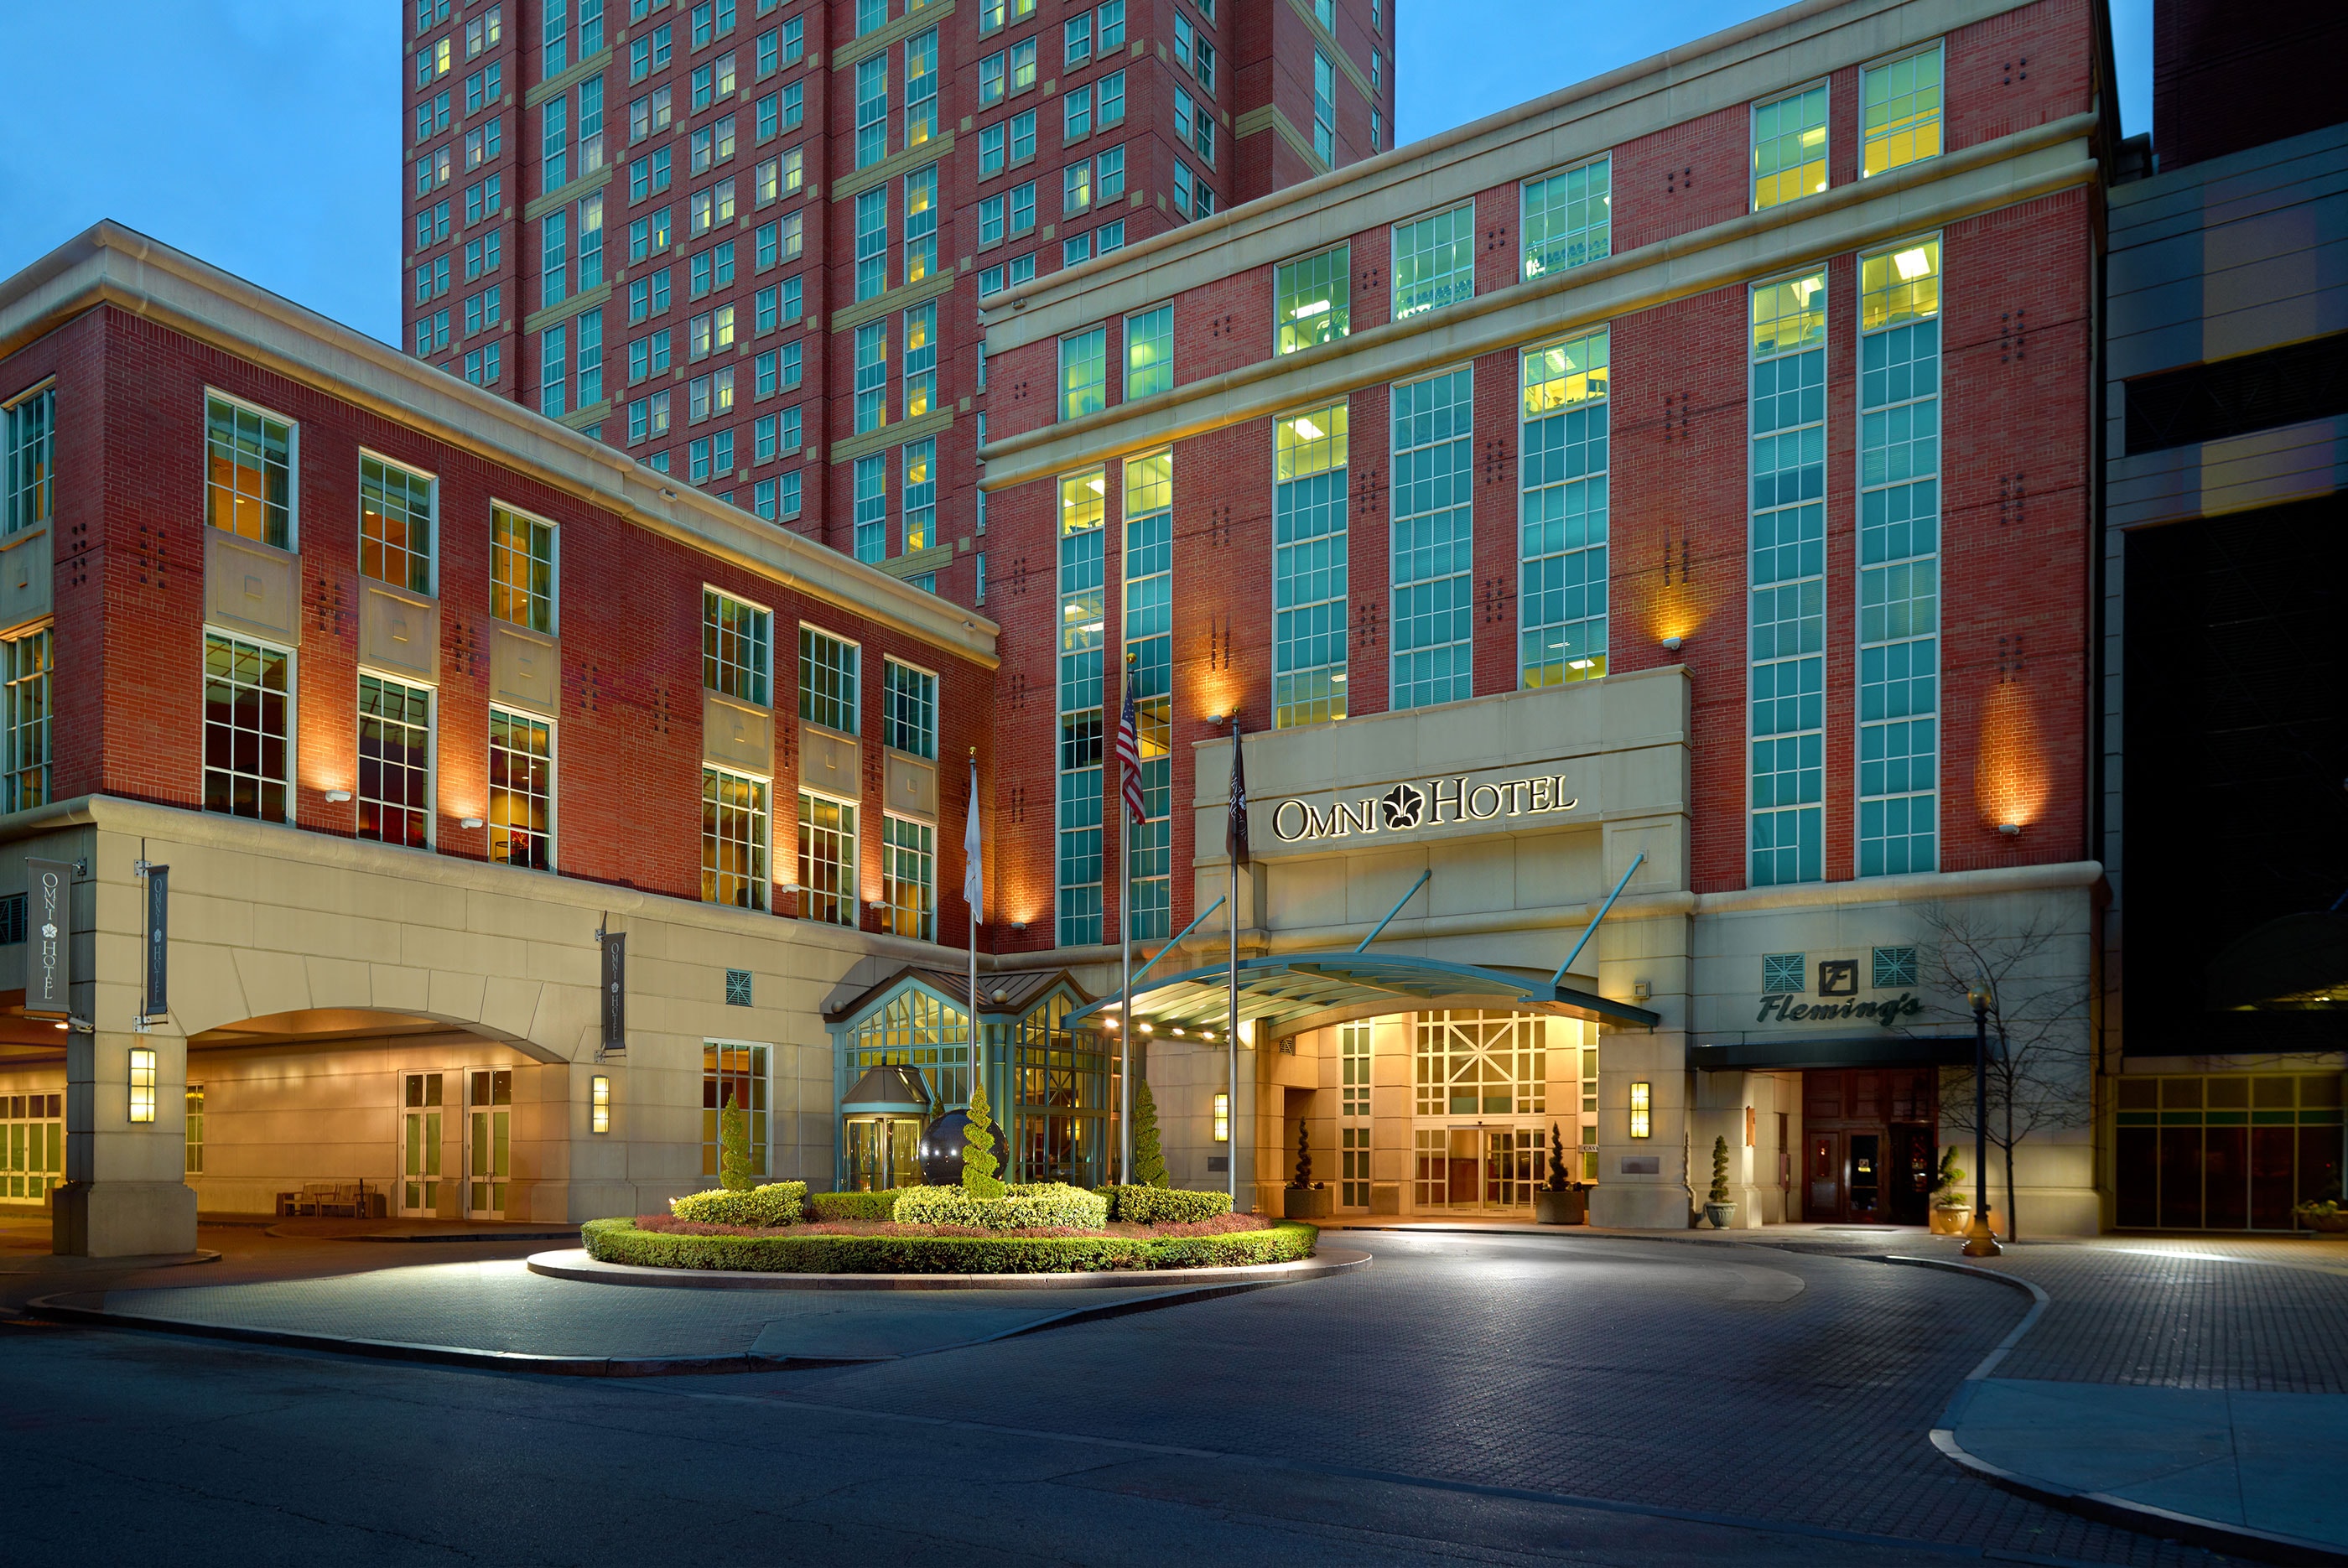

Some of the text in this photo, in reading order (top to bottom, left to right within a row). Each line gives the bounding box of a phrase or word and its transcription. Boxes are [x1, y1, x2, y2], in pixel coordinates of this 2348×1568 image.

[1271, 774, 1578, 842] OMNI HOTEL
[42, 872, 59, 999] OMNI HOTEL
[1756, 992, 1922, 1026] Fleming's
